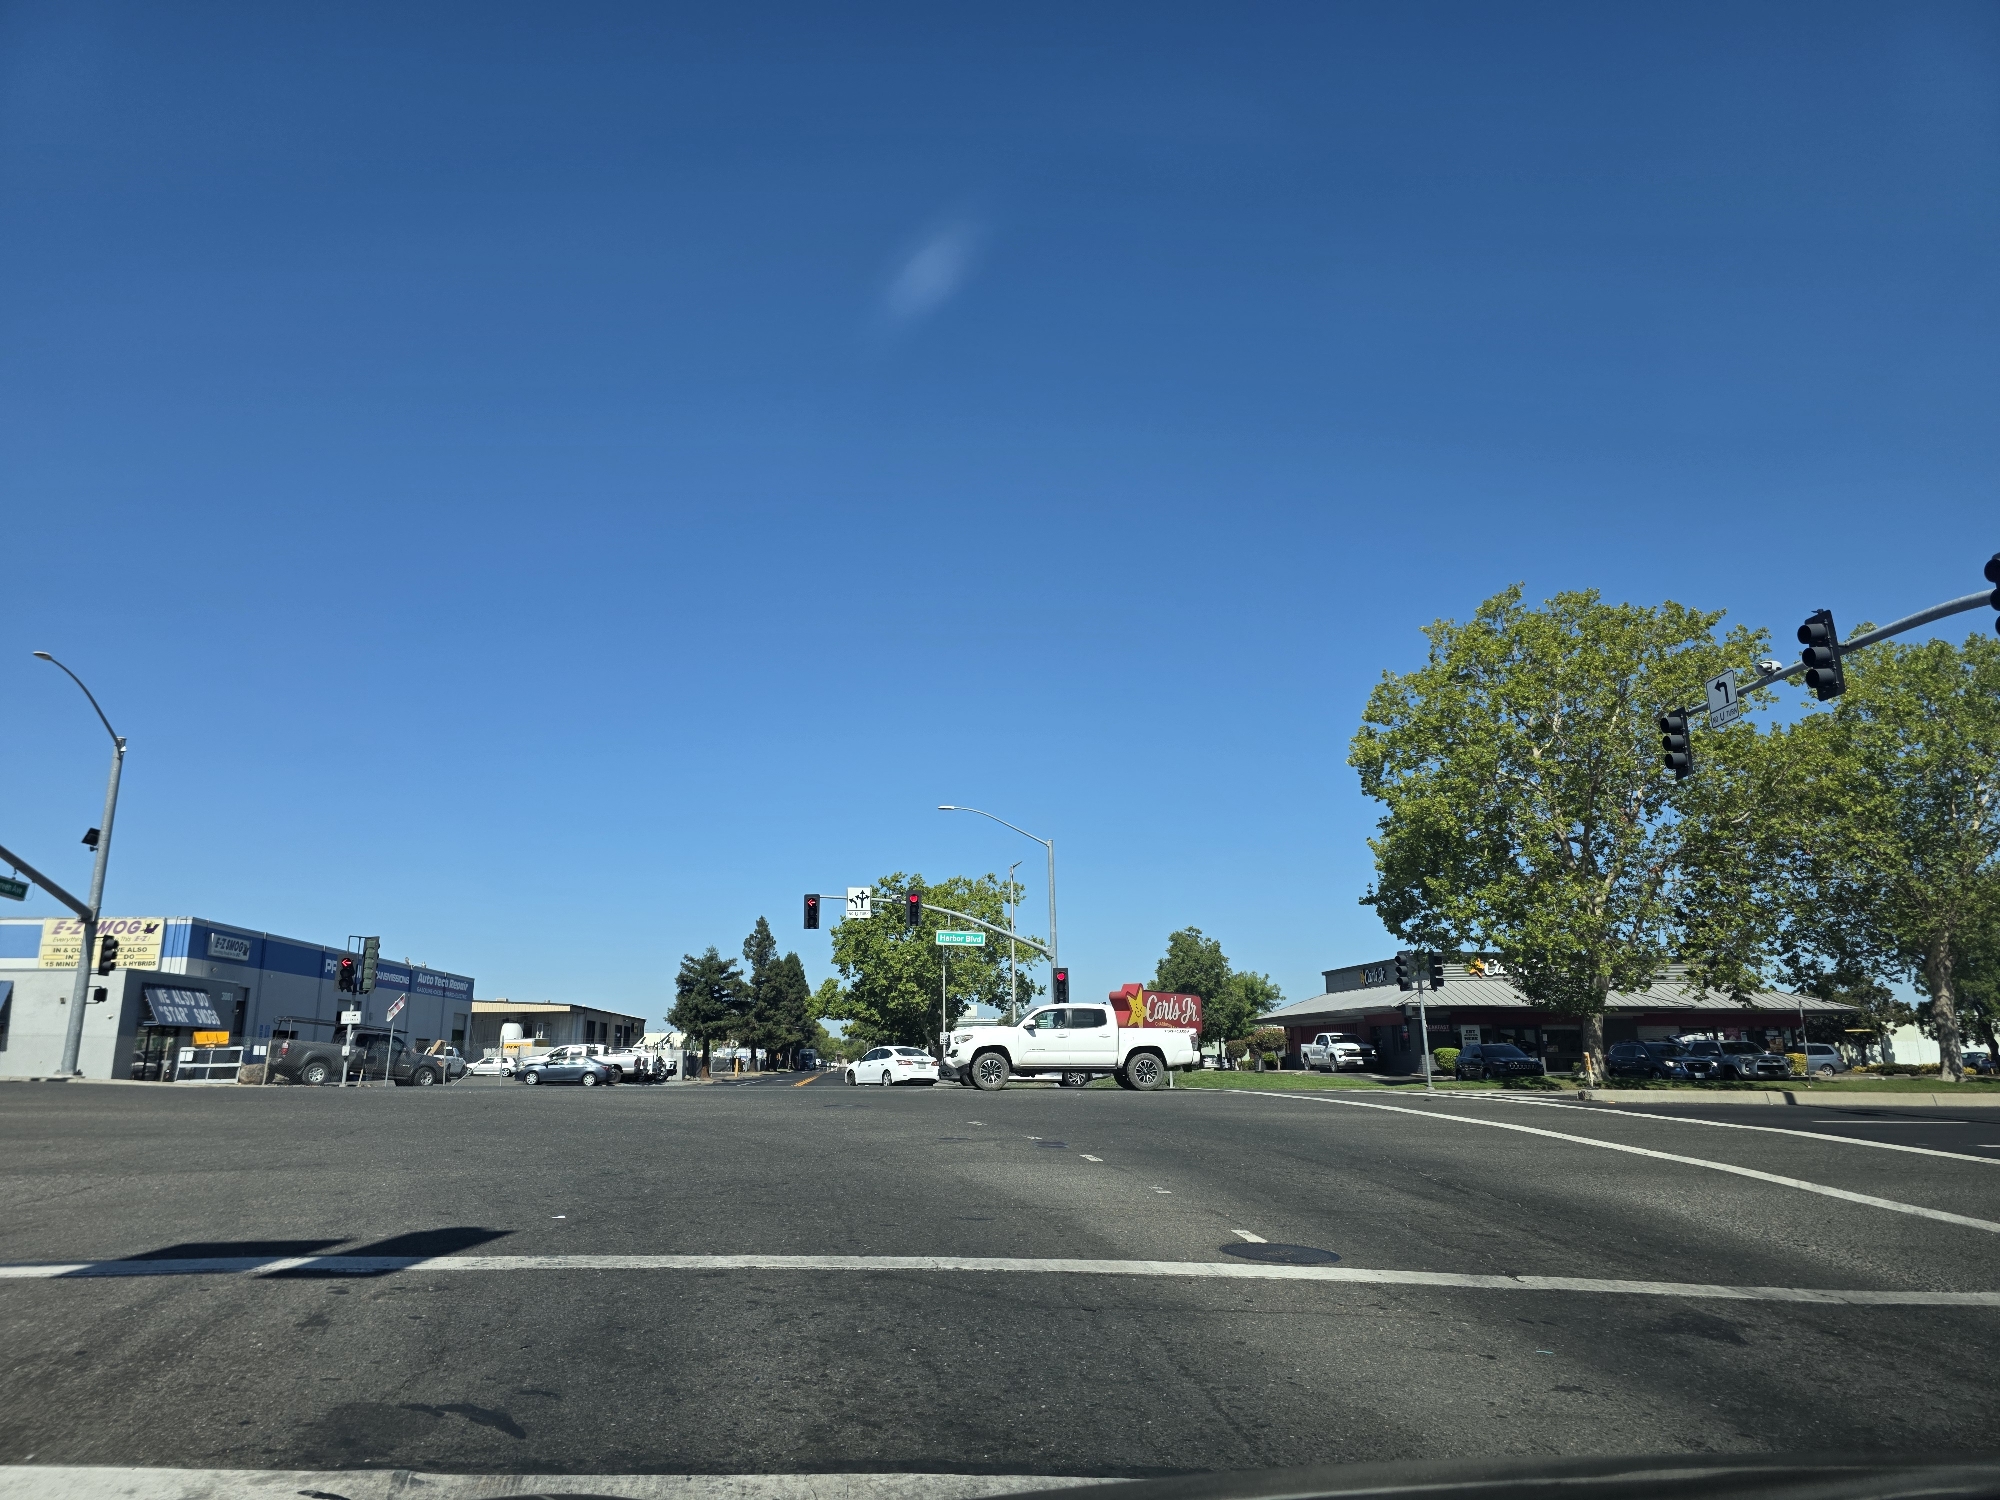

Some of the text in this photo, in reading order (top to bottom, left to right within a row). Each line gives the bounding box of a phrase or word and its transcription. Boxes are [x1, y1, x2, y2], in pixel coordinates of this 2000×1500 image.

[1719, 711, 1724, 721] U
[52, 920, 142, 935] E-Z MOG
[214, 937, 244, 952] E-Z SMOG
[939, 934, 982, 943] Harbor Blvd
[417, 972, 469, 992] Auto Tech Repair
[156, 988, 209, 1007] WE ALSO DO
[158, 1005, 221, 1025] "STAR" SMOGS
[1146, 994, 1200, 1024] Carl's Jr.
